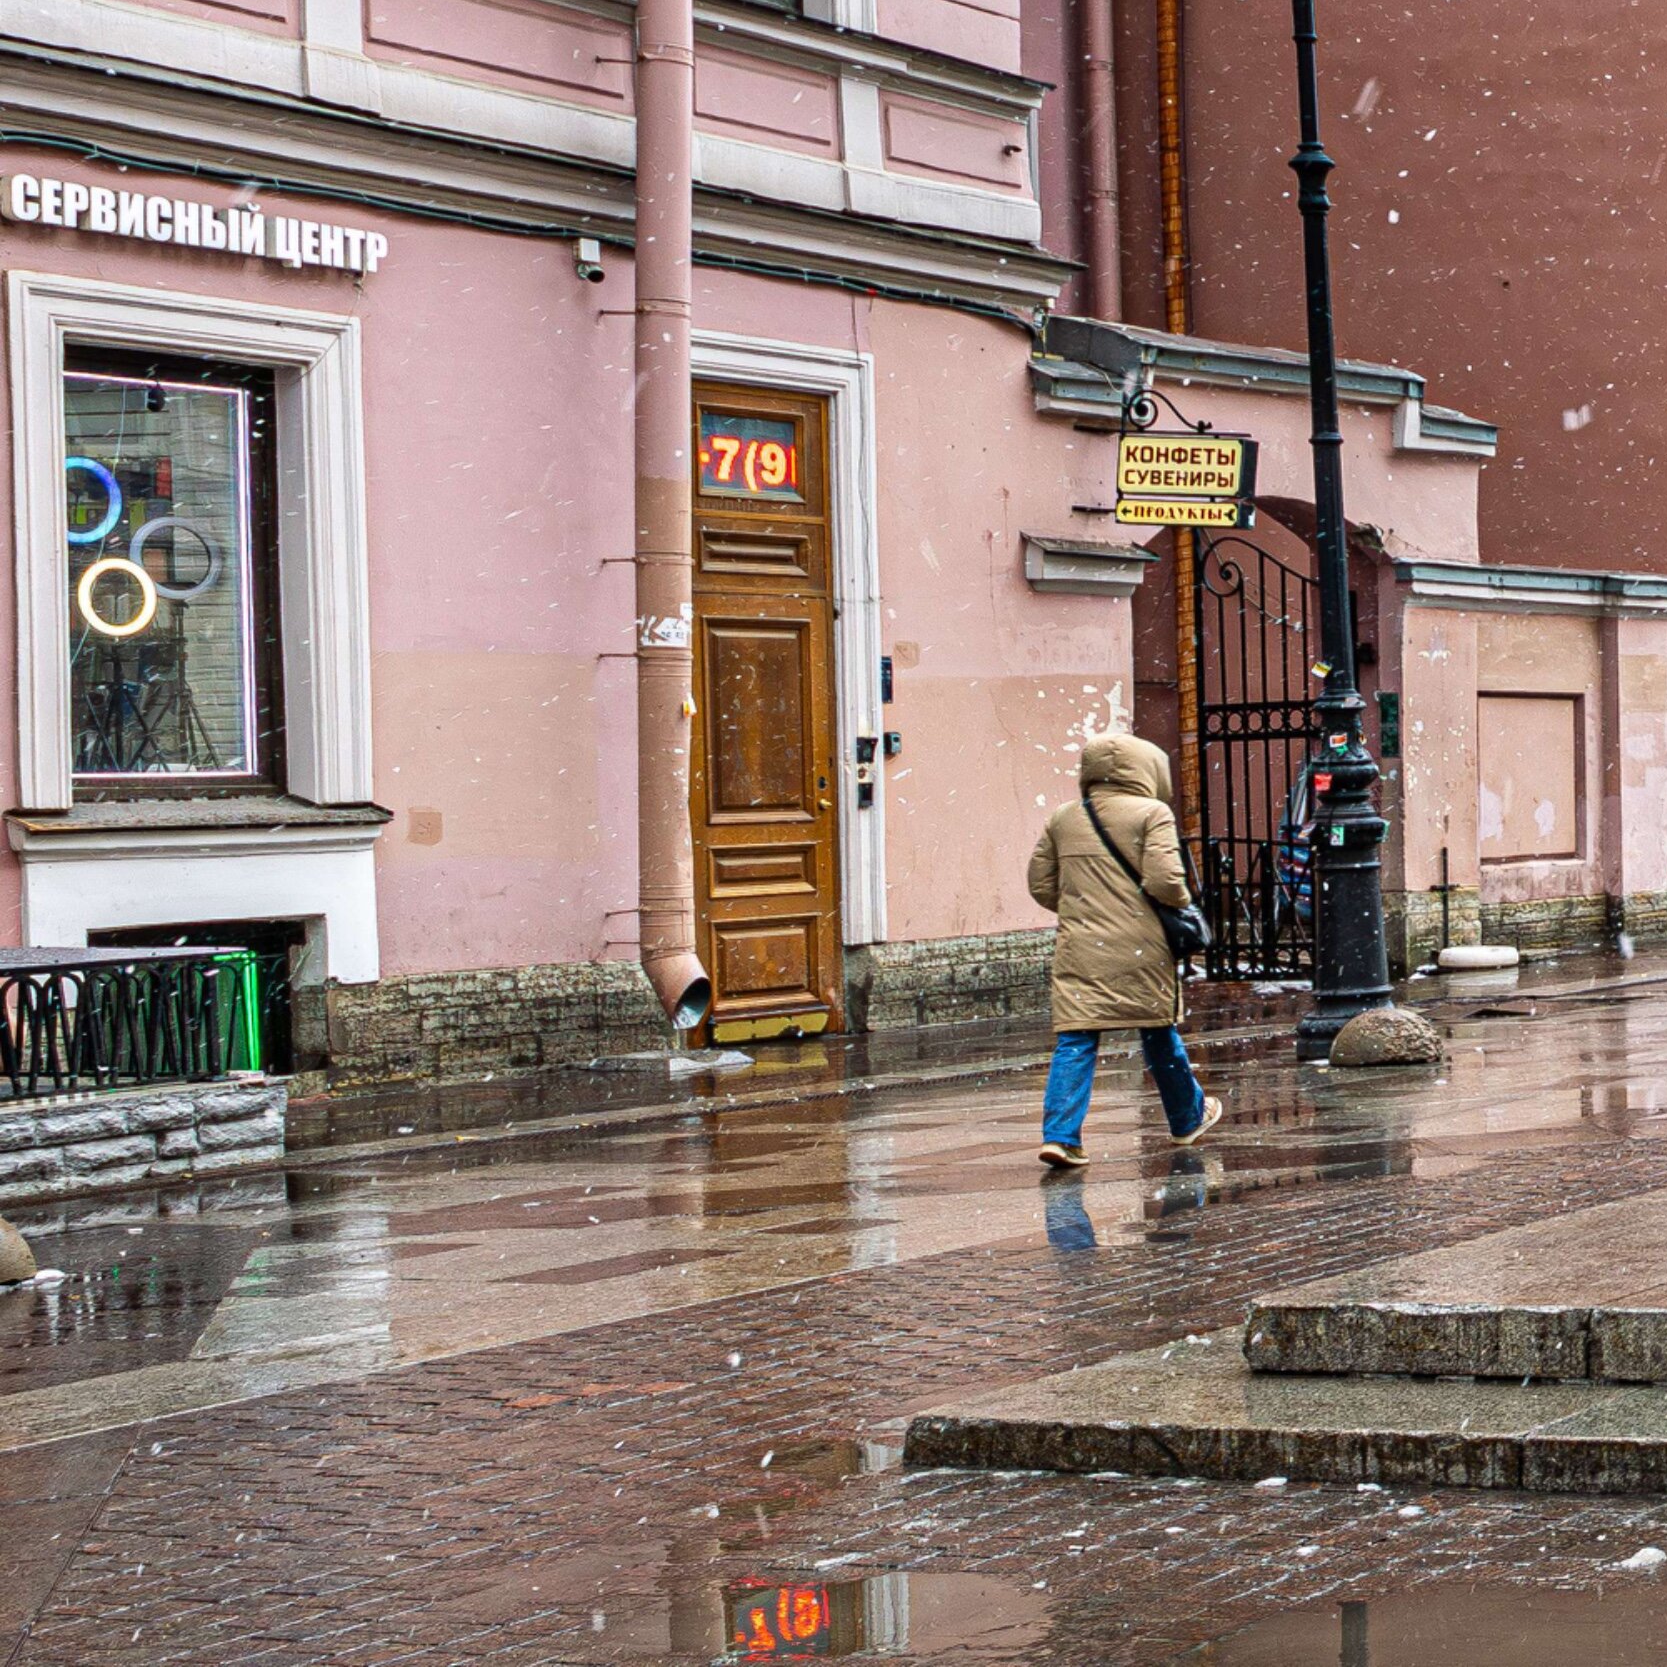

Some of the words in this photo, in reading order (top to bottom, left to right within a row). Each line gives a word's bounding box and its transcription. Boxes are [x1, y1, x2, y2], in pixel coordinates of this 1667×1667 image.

[10, 173, 266, 257] СЕРВИСНЫЙ
[275, 216, 388, 273] ЦЕНТР
[699, 435, 797, 494] 7(9
[1125, 445, 1236, 466] КОНФЕТЫ
[1124, 469, 1234, 488] СУВЕНИРЫ
[1133, 505, 1223, 520] ПРОДУКТЫ
